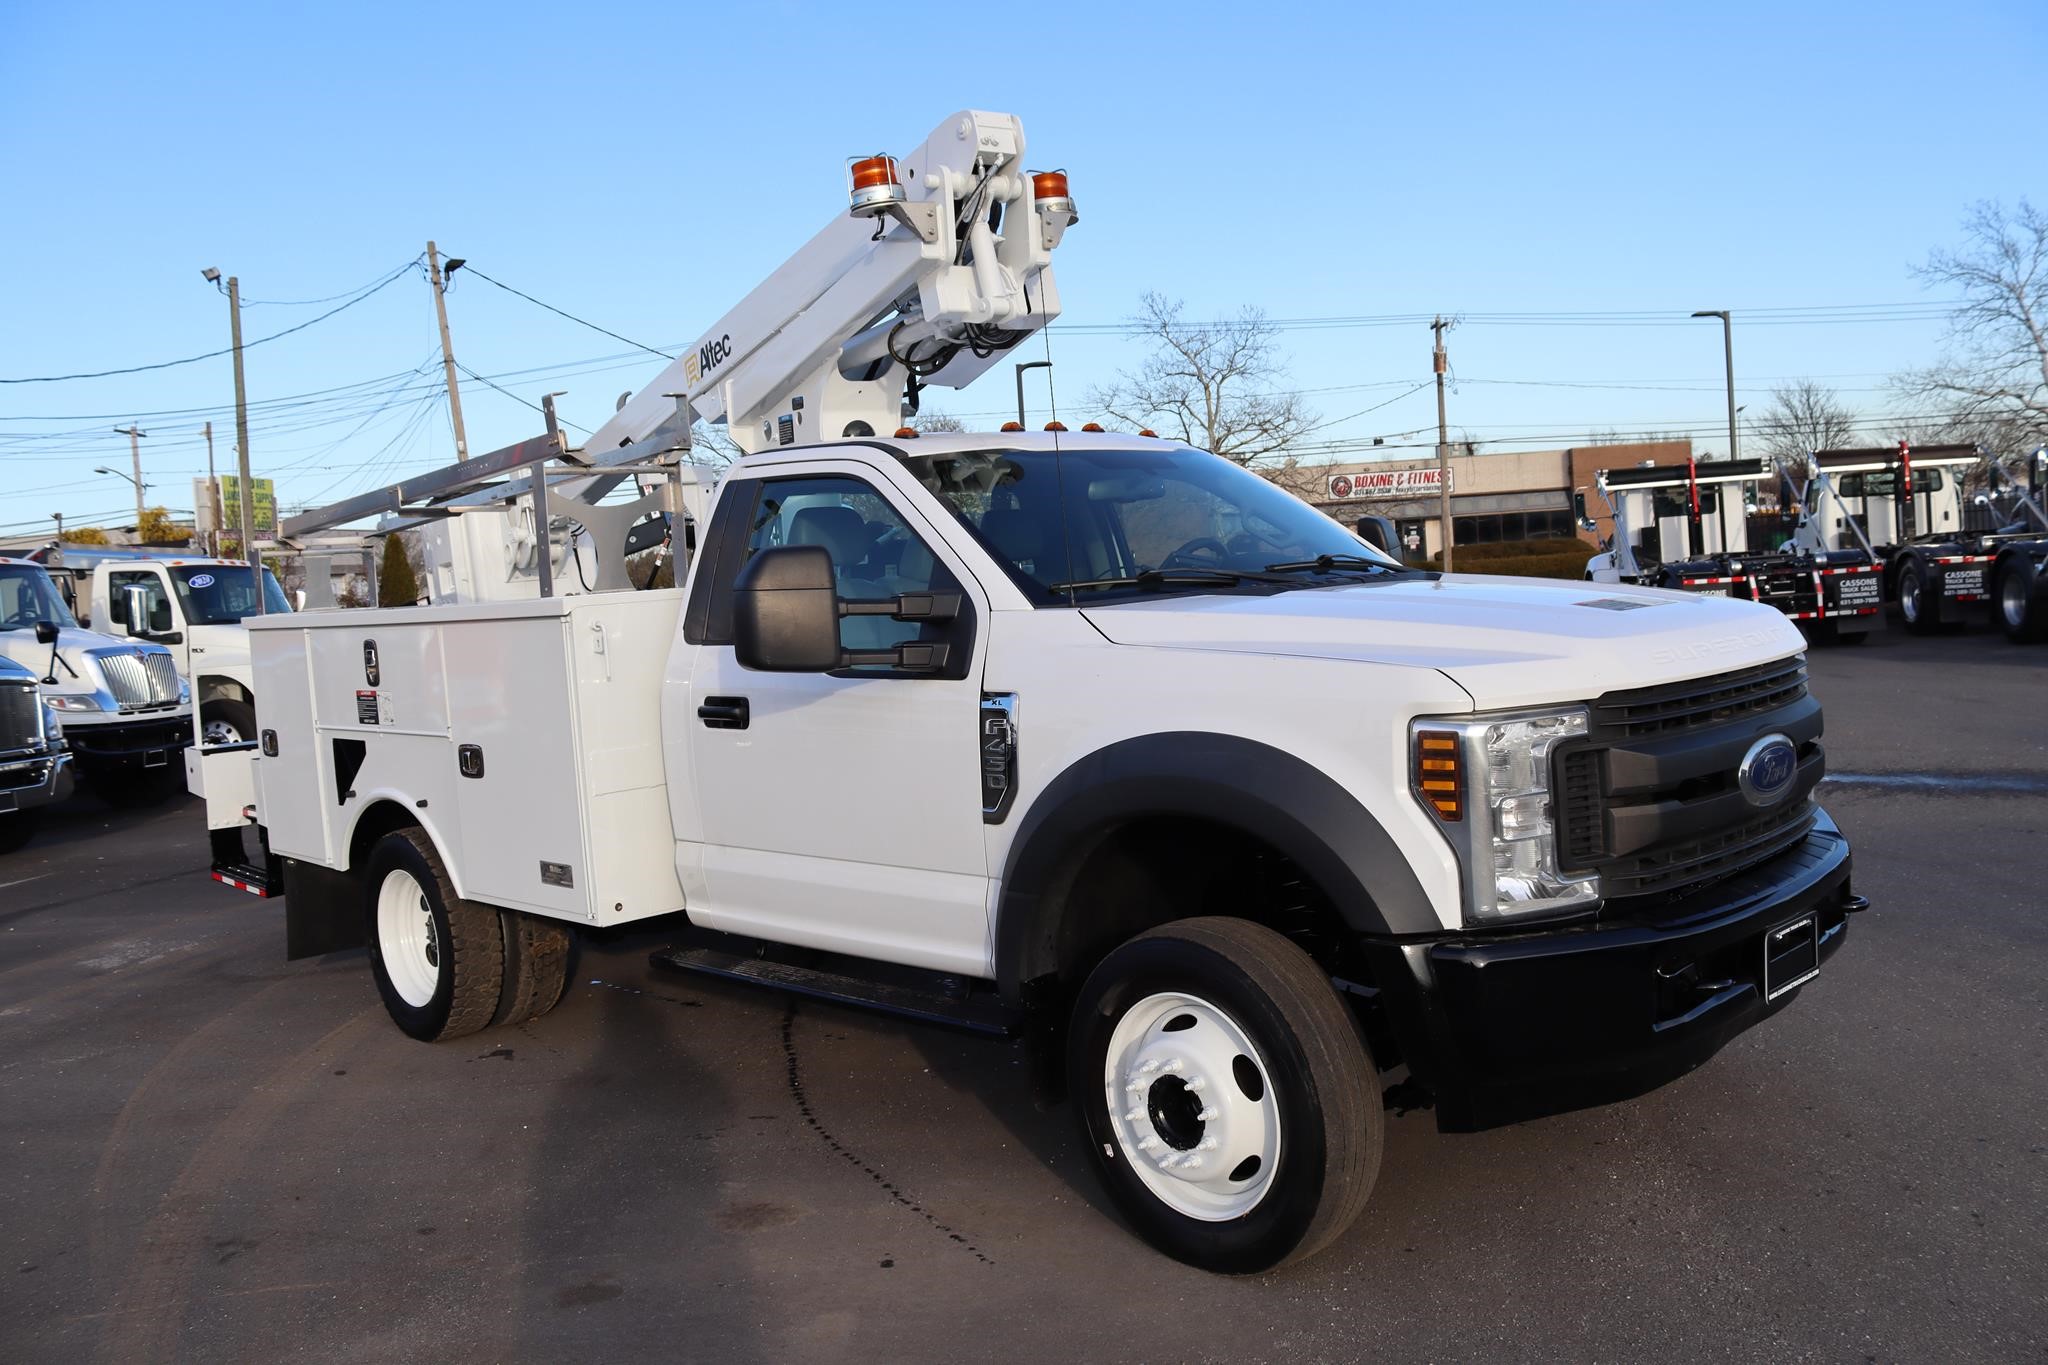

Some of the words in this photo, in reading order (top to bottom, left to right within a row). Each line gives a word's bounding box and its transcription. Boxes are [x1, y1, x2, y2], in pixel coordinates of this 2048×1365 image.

[700, 333, 731, 378] Altec
[1354, 474, 1394, 488] BOXING
[1397, 473, 1404, 486] &
[1944, 570, 1982, 579] CASSONE
[1840, 578, 1877, 587] CASSONE
[1763, 751, 1789, 785] Ford
